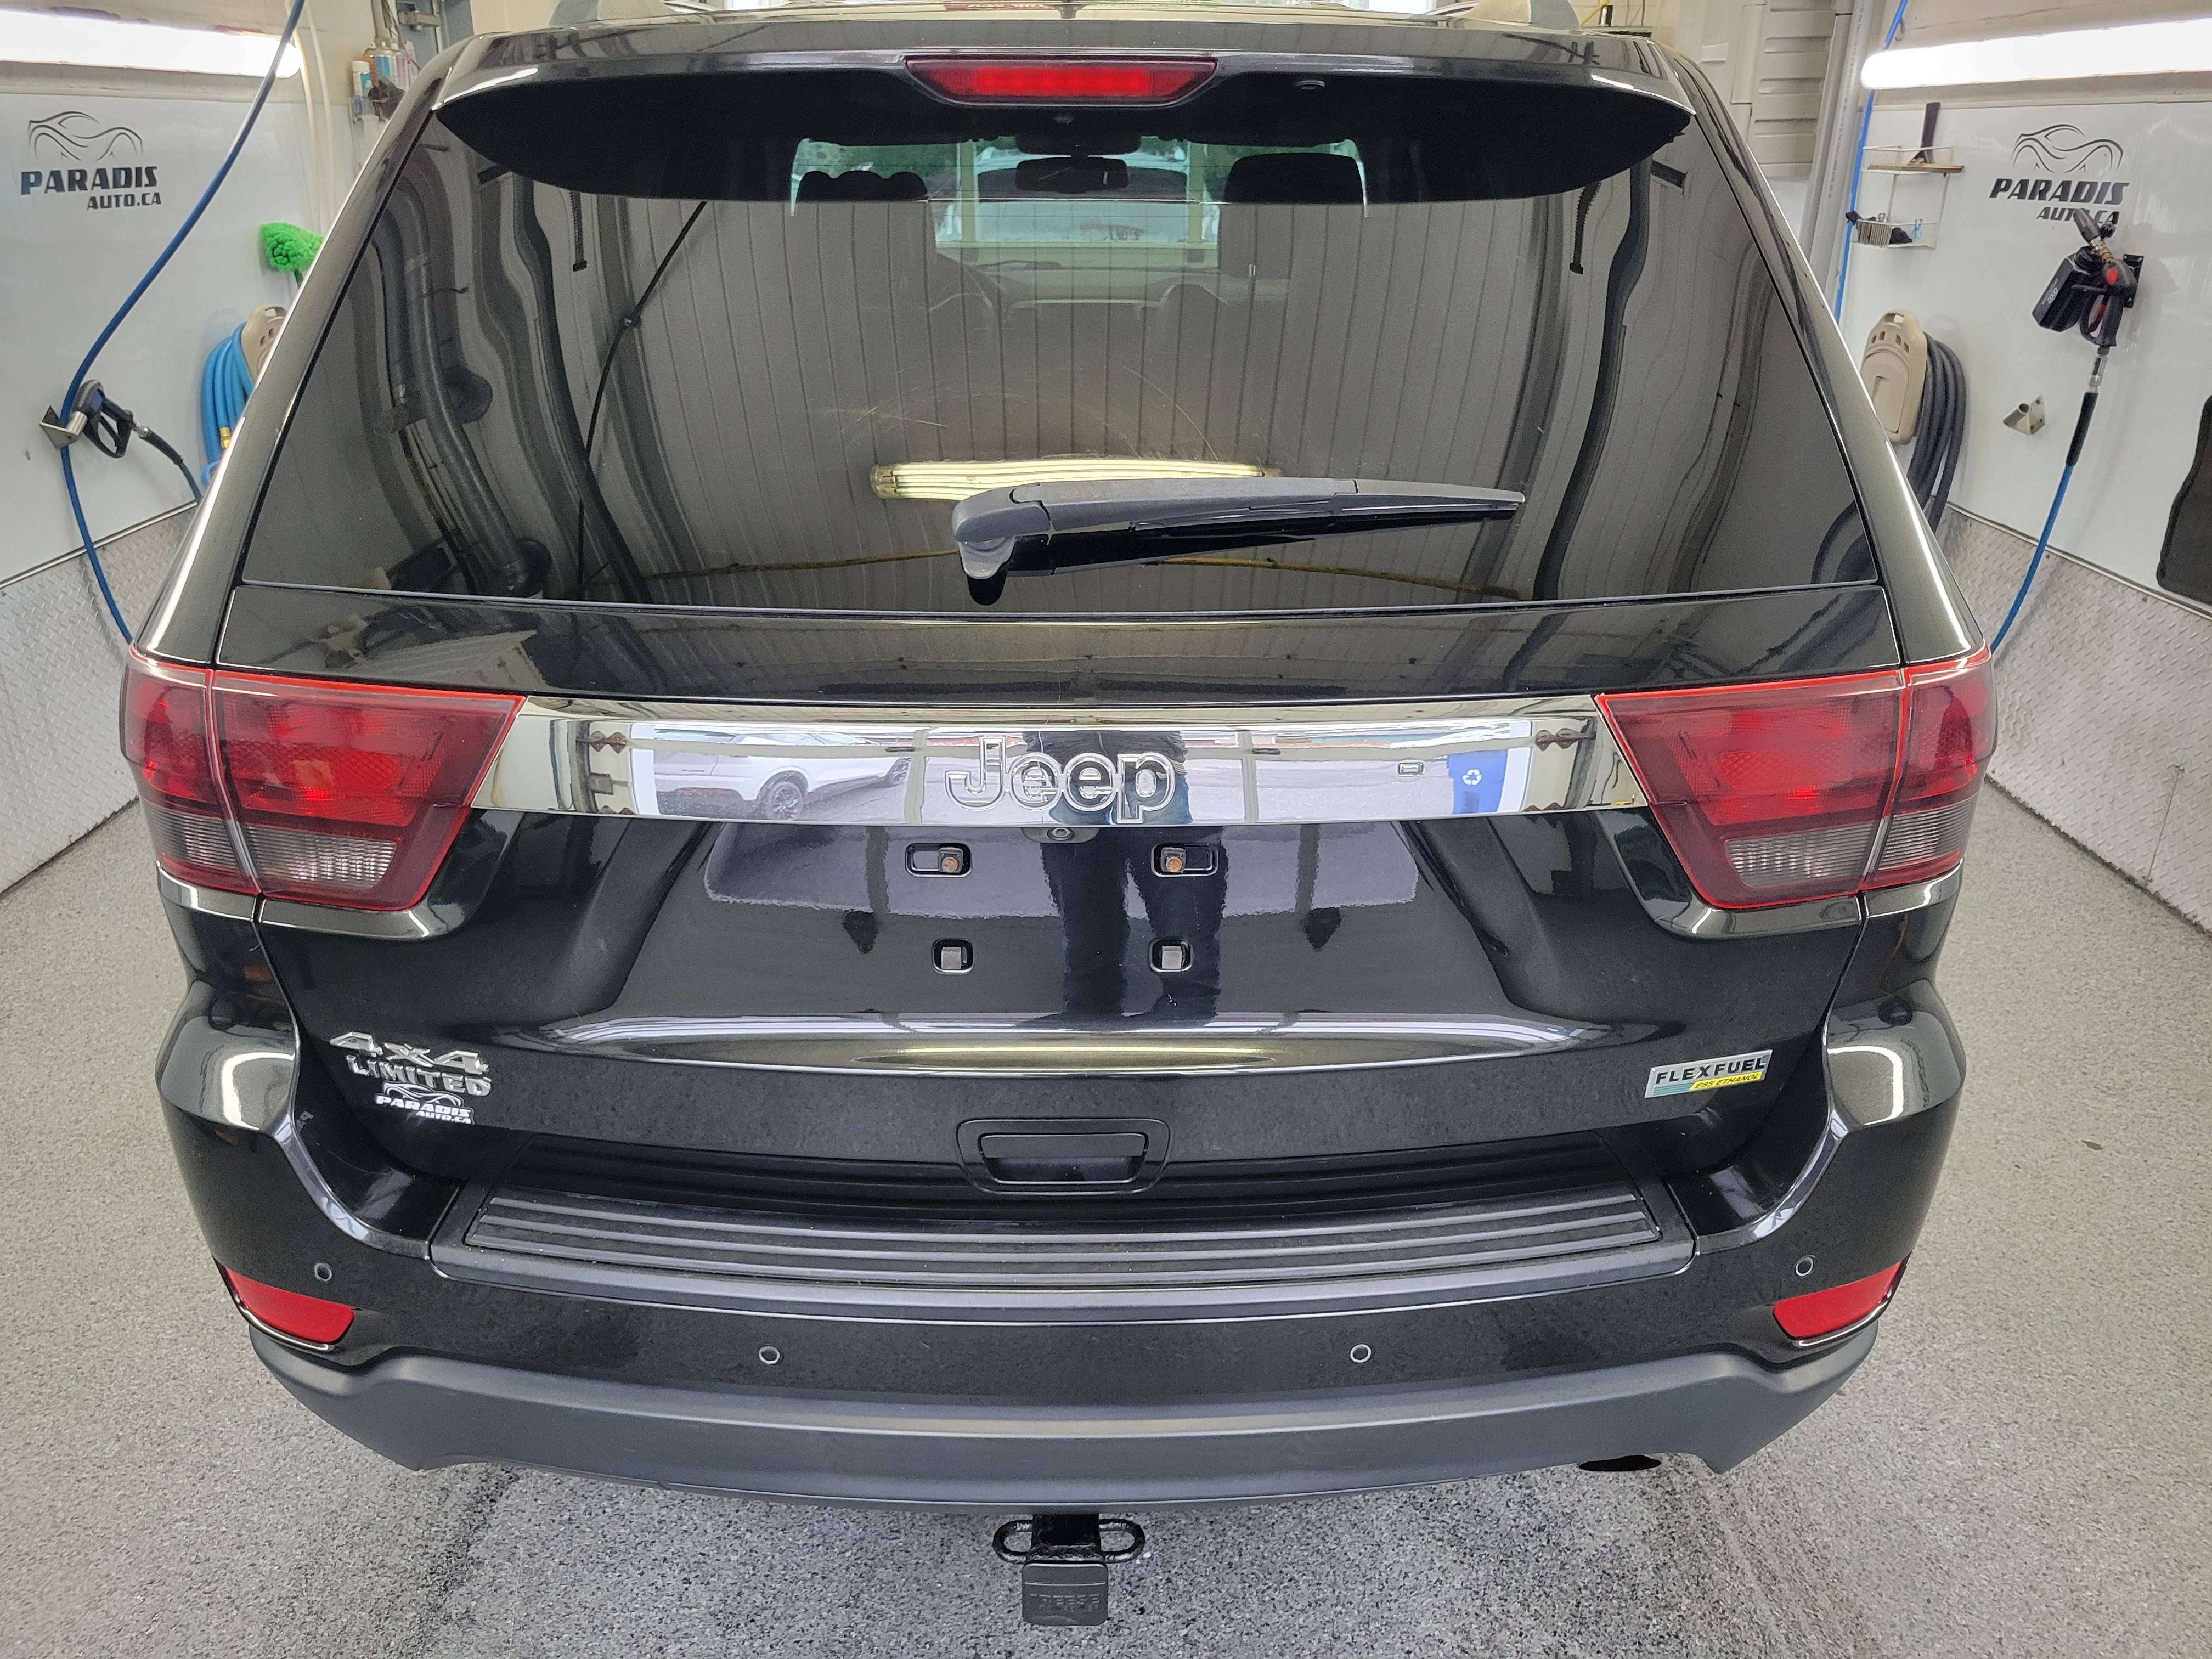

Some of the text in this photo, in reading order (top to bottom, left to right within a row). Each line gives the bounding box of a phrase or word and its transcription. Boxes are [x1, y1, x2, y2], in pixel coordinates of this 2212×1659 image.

[21, 166, 157, 195] PARADIS
[1989, 178, 2130, 205] PARADIS
[87, 192, 162, 211] AUTO.CA
[2036, 207, 2120, 225] AUTCA
[944, 735, 1176, 823] Jeep
[346, 1054, 492, 1096] LIMITED
[1655, 1057, 1767, 1085] FLEXFUEL
[1694, 1073, 1760, 1089] E85 ETHANOL
[376, 1095, 471, 1118] PARADIS
[416, 1110, 471, 1124] AUTO.CA
